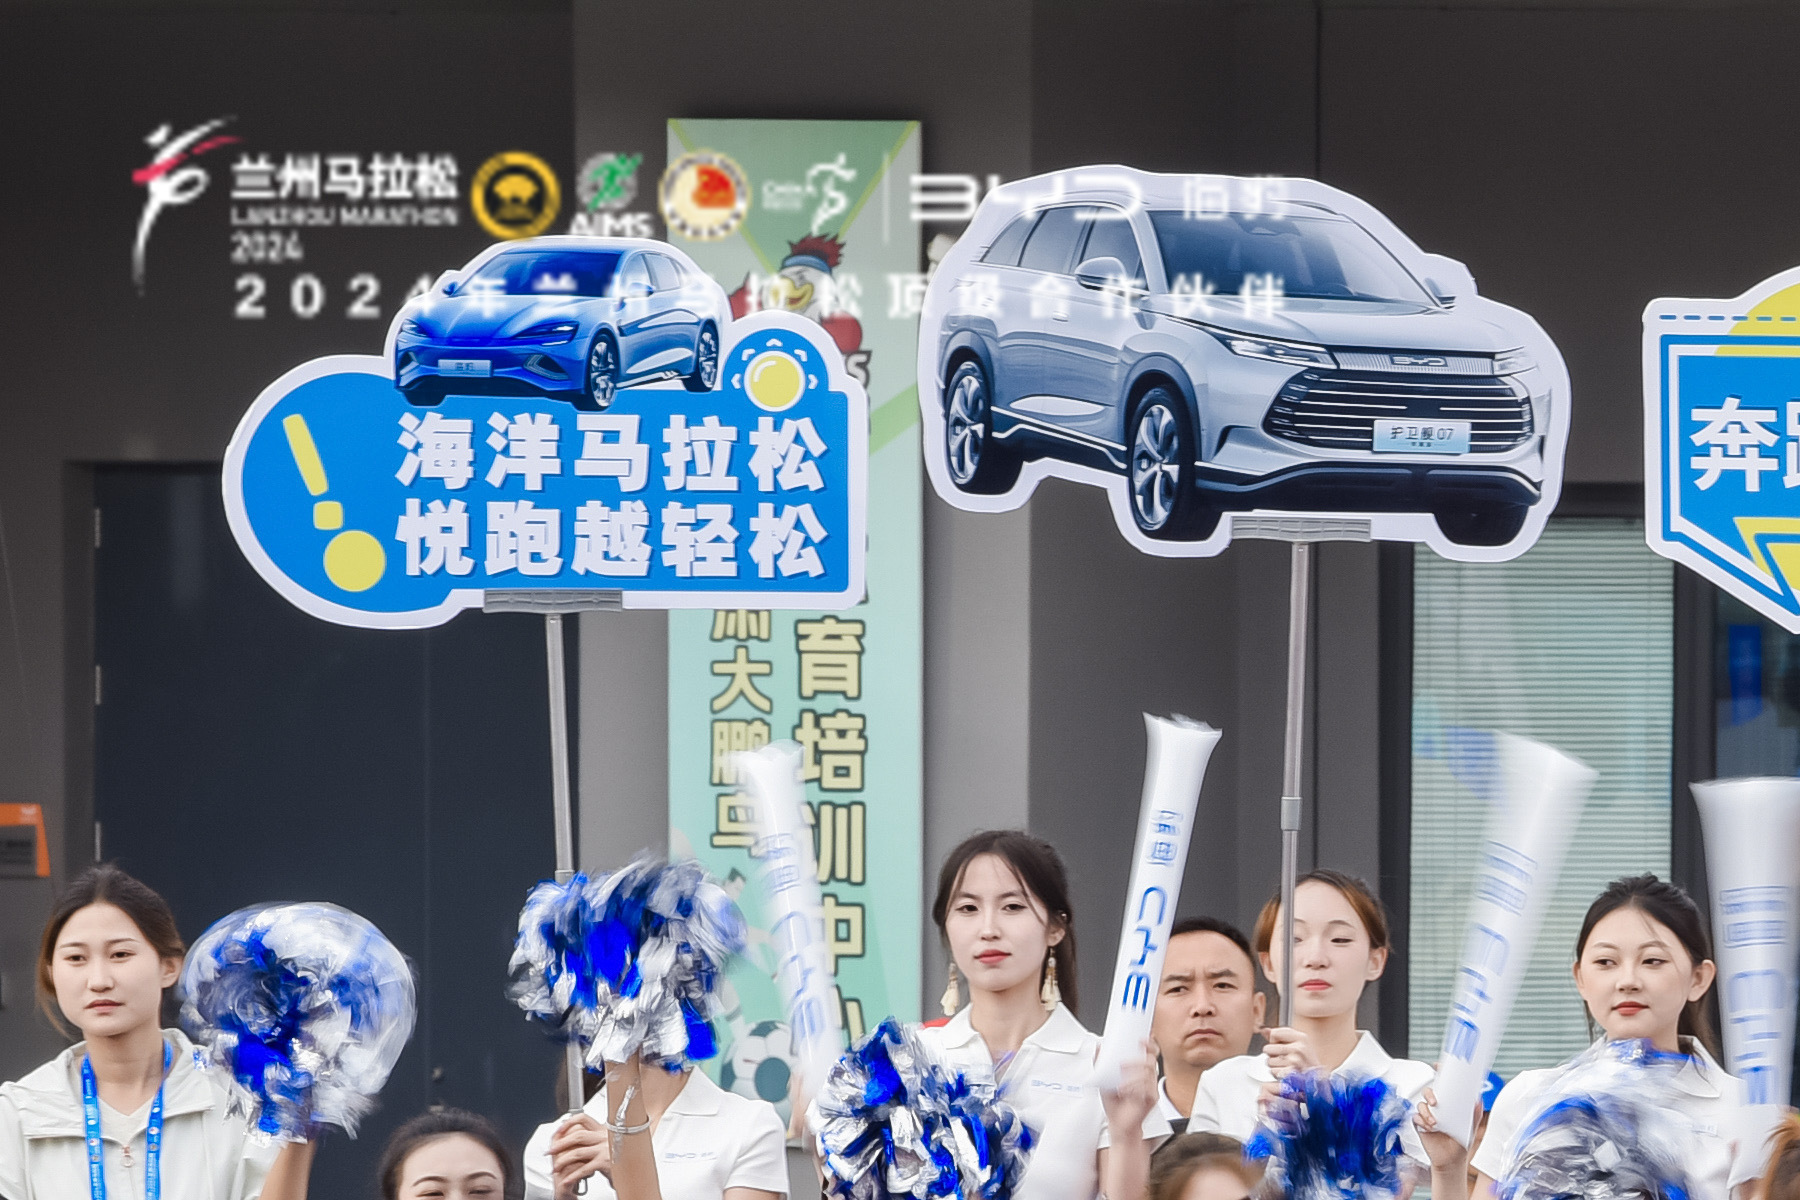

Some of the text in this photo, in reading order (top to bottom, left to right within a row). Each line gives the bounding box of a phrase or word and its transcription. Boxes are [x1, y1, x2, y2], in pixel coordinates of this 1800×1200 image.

[395, 410, 828, 493] 海洋马拉松
[394, 499, 828, 580] 悦跑越轻松
